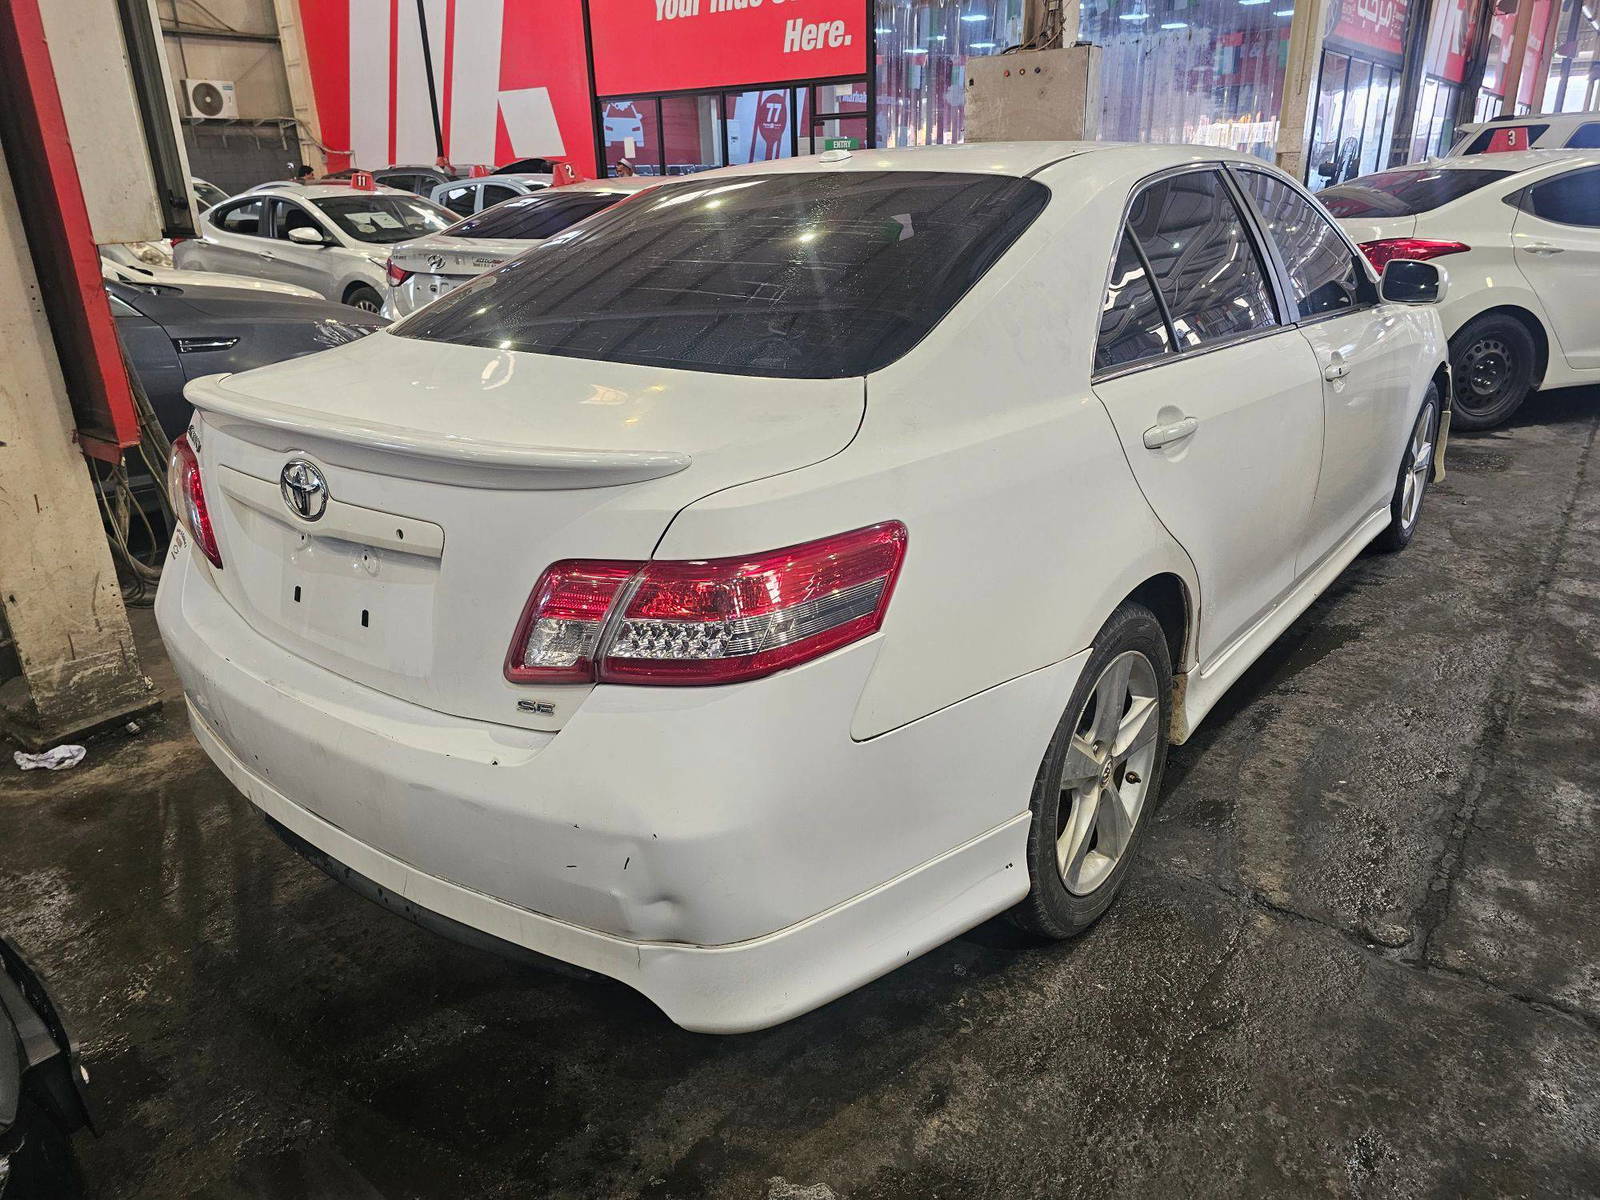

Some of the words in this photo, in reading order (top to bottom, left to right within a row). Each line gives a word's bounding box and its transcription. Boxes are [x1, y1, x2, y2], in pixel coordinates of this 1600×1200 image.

[656, 0, 700, 22] Your
[783, 18, 852, 53] Here.
[766, 103, 782, 123] 77
[833, 140, 852, 149] ENTRY
[1507, 130, 1516, 146] 3
[565, 164, 575, 179] 2
[357, 175, 366, 187] 11
[516, 699, 556, 717] SE
